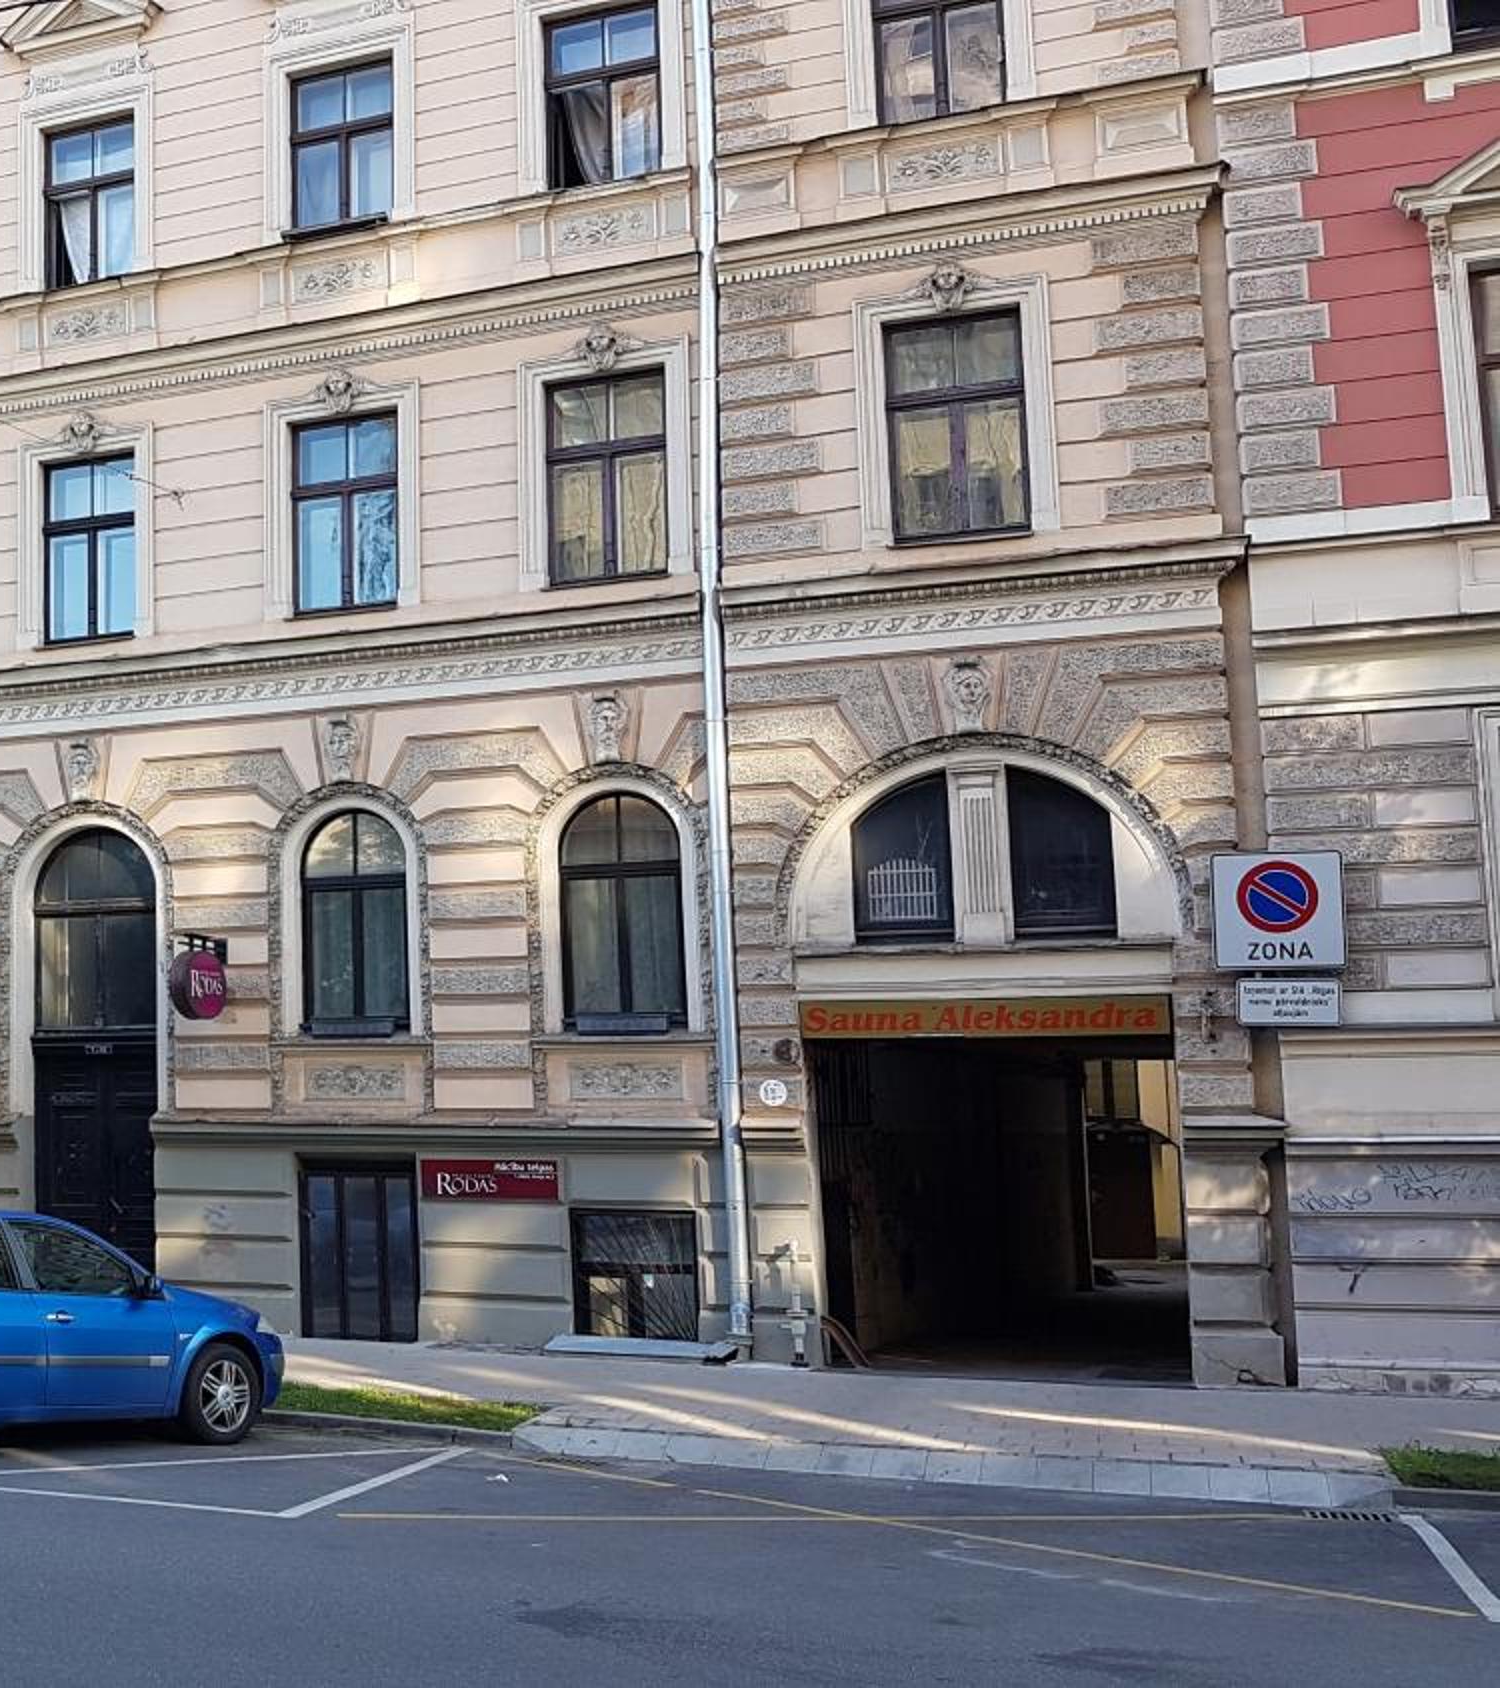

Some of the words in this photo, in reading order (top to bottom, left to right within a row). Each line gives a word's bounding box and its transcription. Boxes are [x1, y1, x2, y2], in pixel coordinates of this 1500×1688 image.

[1247, 941, 1314, 960] ZONA
[804, 1007, 922, 1033] Sauna
[437, 1172, 498, 1195] RODAS
